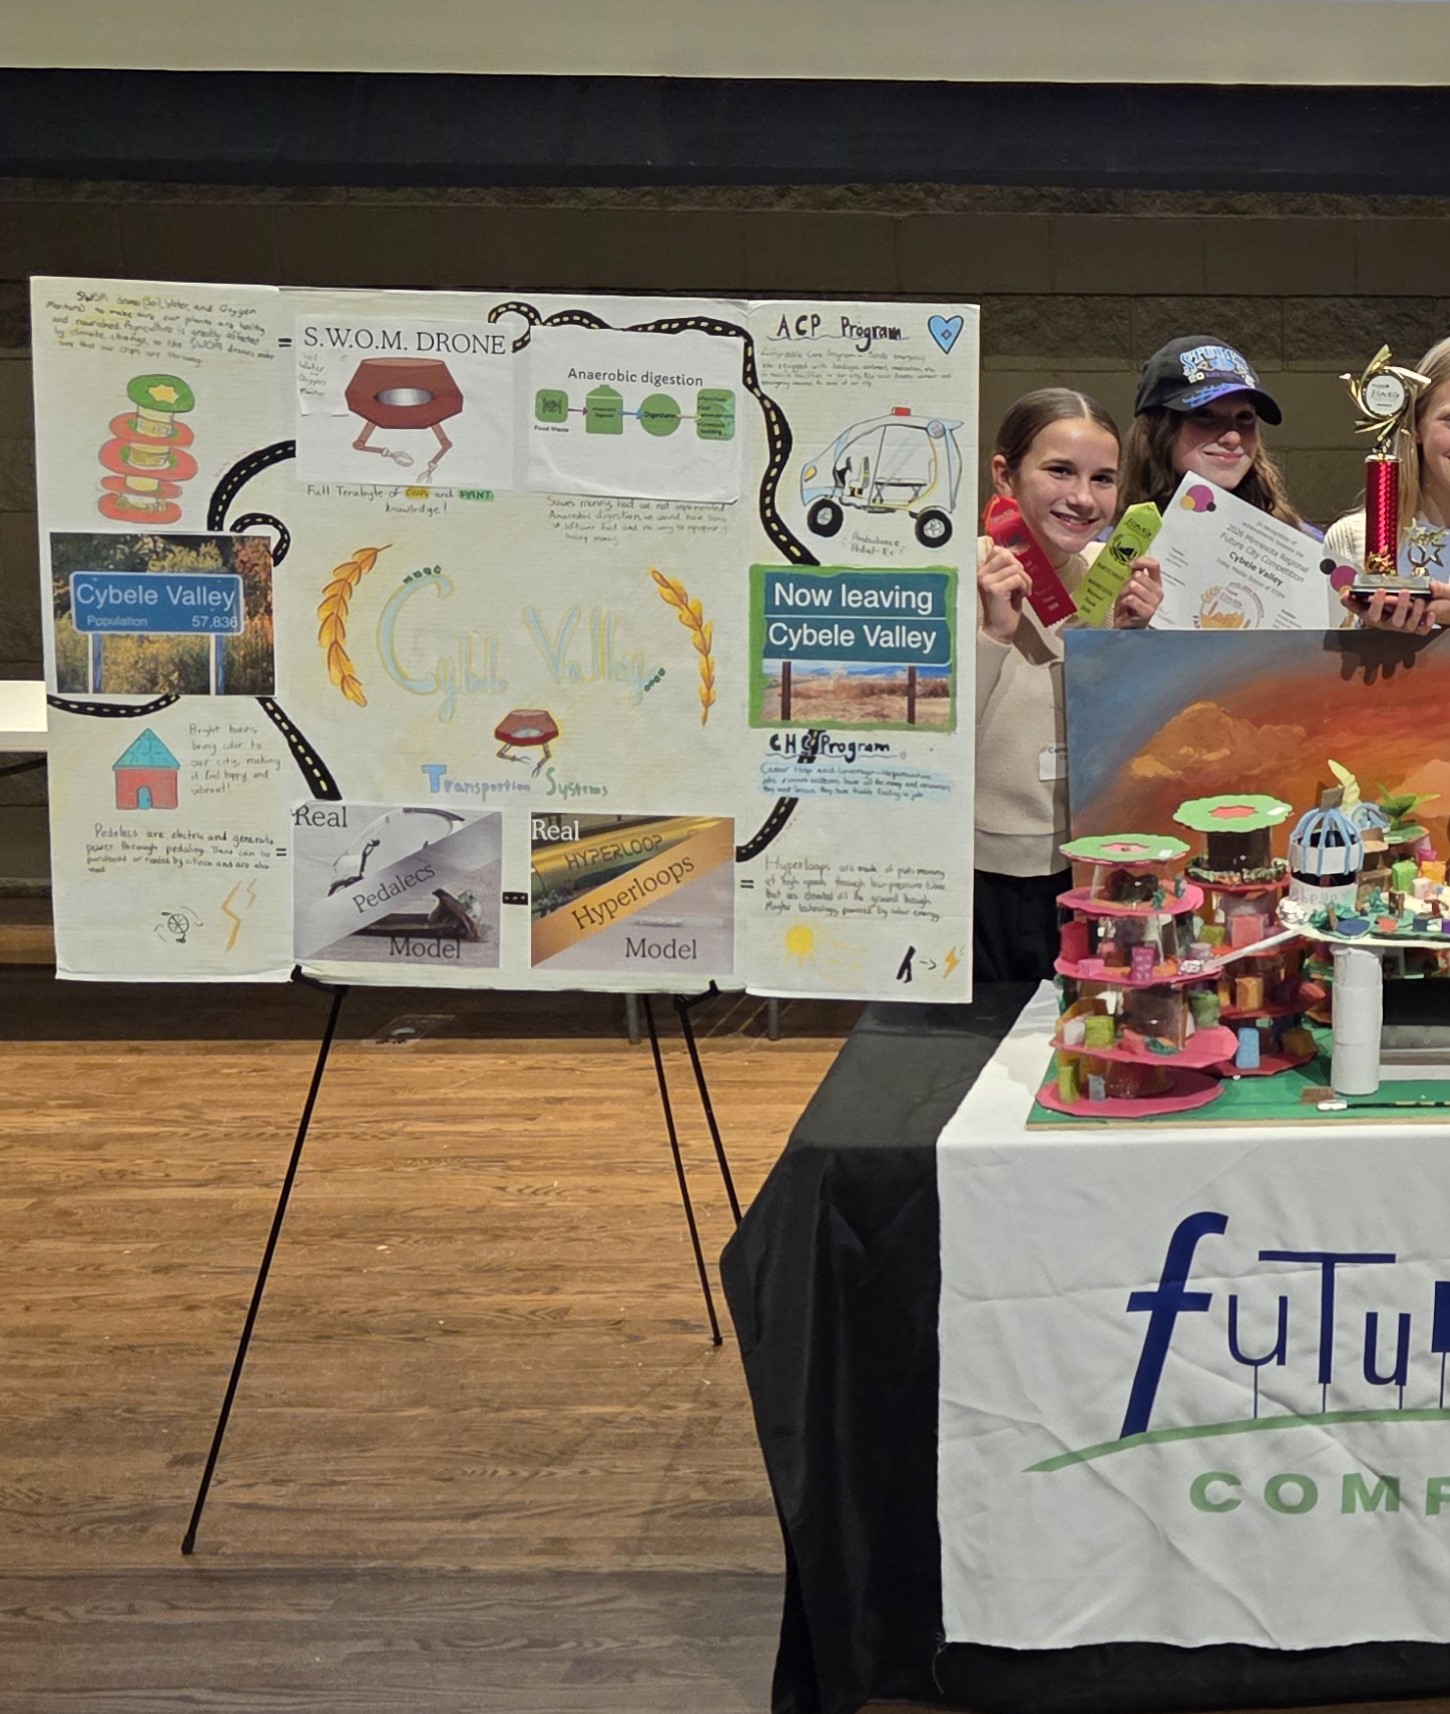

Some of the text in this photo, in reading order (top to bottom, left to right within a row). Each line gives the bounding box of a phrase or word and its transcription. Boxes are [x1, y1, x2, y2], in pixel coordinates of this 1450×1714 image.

[304, 326, 506, 355] S.W.O.M. DRONE
[776, 313, 901, 352] ACP Program
[568, 367, 703, 387] Anaerobic digestion
[307, 485, 331, 497] Full
[336, 484, 384, 501] Terabyte
[435, 487, 454, 498] and
[1219, 531, 1306, 584] Future City Competition
[1227, 550, 1285, 588] Cybele Valley
[1243, 534, 1280, 558] Minnesota
[1278, 552, 1310, 575] Regional
[76, 583, 236, 611] Cybele Valley
[774, 582, 933, 615] Now leaving
[87, 615, 239, 629] Population 57,836
[768, 622, 937, 655] Cybele Valley
[820, 734, 890, 764] Program
[545, 766, 609, 800] Systems
[292, 806, 348, 829] Real
[531, 819, 580, 842] Real
[146, 830, 164, 839] are
[208, 830, 227, 841] and
[563, 833, 663, 871] HYPERLOOP
[571, 854, 696, 931] Hyperloops
[389, 936, 461, 959] Model
[625, 937, 698, 960] Model
